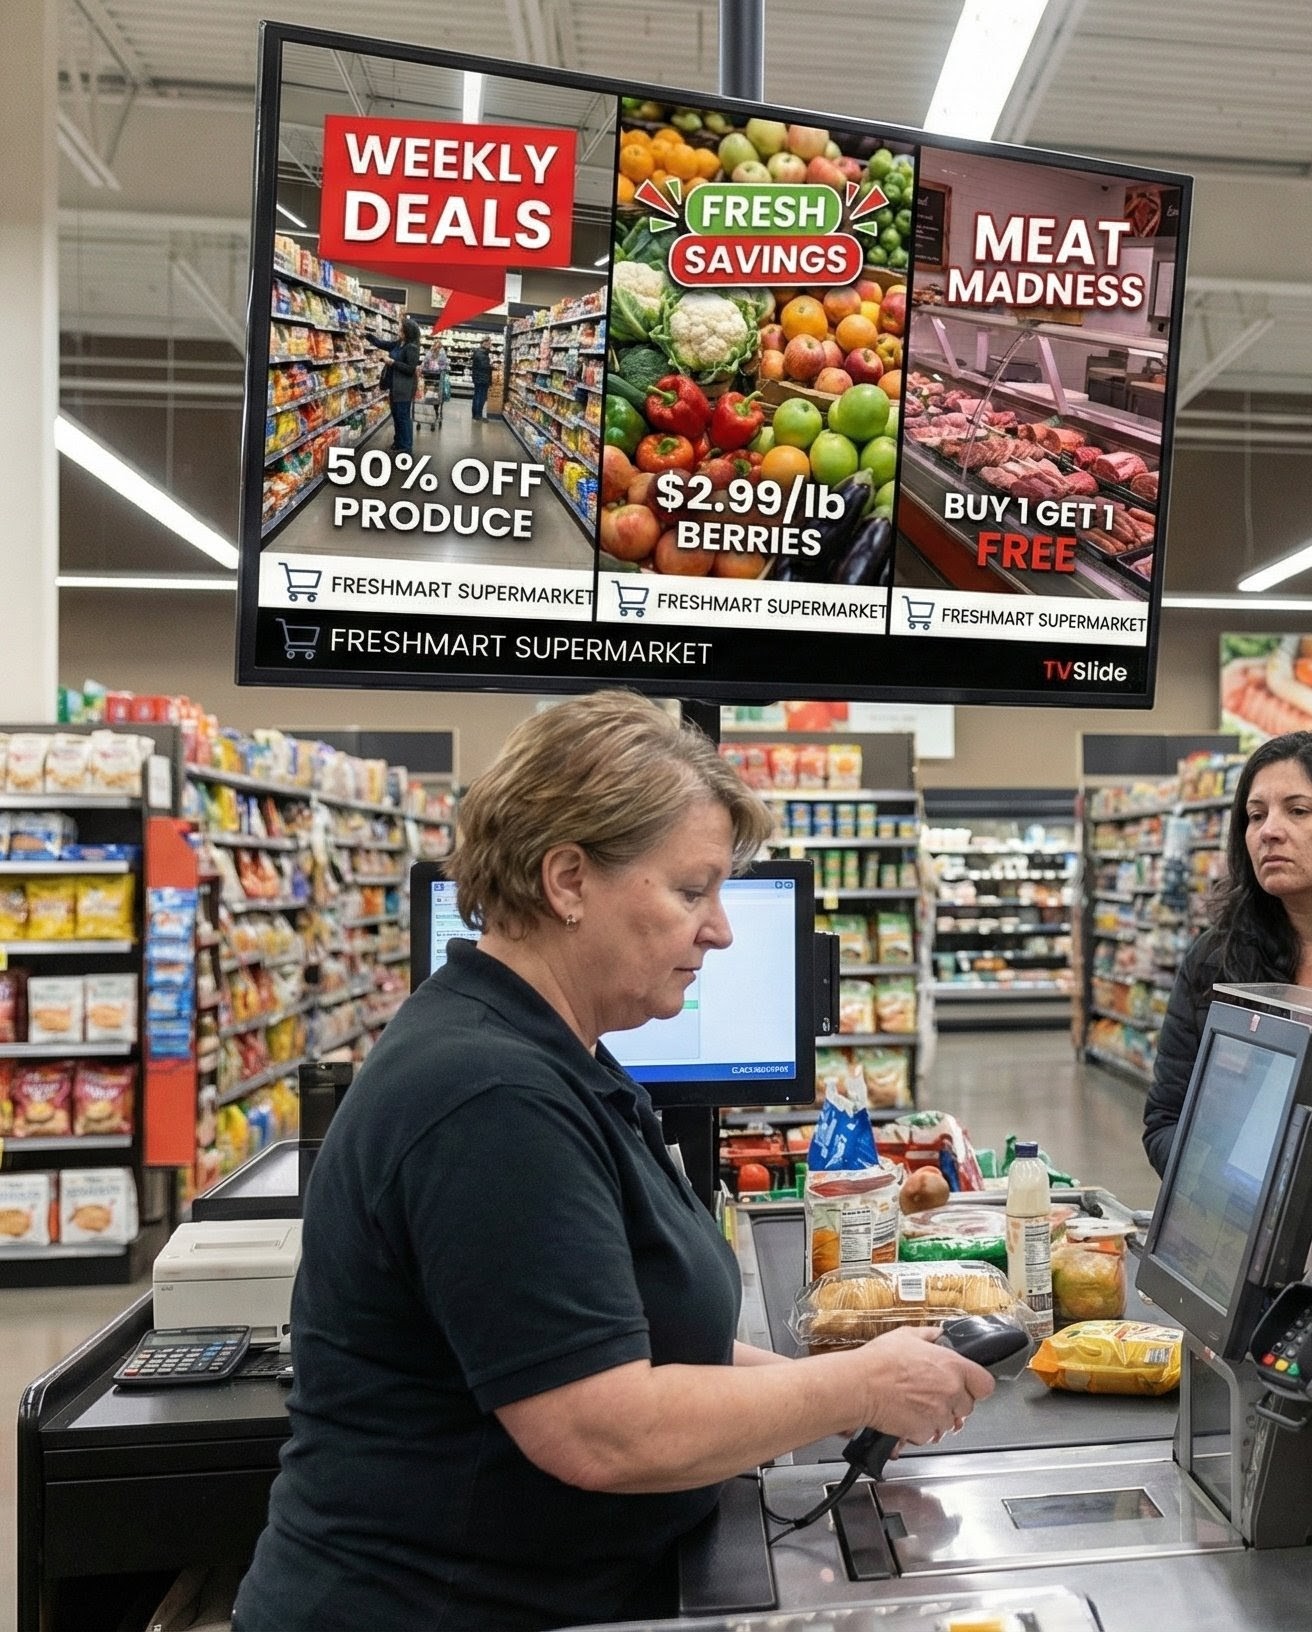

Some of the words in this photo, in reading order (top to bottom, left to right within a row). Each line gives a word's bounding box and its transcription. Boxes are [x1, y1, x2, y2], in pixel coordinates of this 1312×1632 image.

[344, 132, 559, 184] WEEKLY
[343, 189, 552, 249] DEALS
[701, 194, 826, 228] FRESH
[974, 213, 1132, 267] MEAT
[683, 245, 848, 275] SAVINGS
[947, 268, 1146, 308] MADNESS
[327, 446, 438, 493] 50%
[451, 457, 546, 498] OFF
[656, 470, 846, 525] $2.99/lb
[943, 492, 1011, 524] BUY
[1017, 497, 1029, 525] 1
[1035, 499, 1100, 530] GET
[1103, 504, 1115, 531] 1
[333, 496, 534, 539] PRODUCE
[676, 520, 823, 557] BERRIES
[976, 530, 1079, 573] FREE
[331, 576, 452, 599] FRESHMART
[457, 582, 595, 606] SUPERMARKET
[657, 592, 763, 613] FRESHMART
[766, 597, 888, 620] SUPERMARKET
[941, 607, 1034, 627] FRESHMART
[1038, 612, 1148, 633] SUPERMARKET
[330, 628, 507, 658] FRESHMART
[515, 635, 713, 666] SUPERMARKET
[1043, 660, 1128, 683] TVSlide
